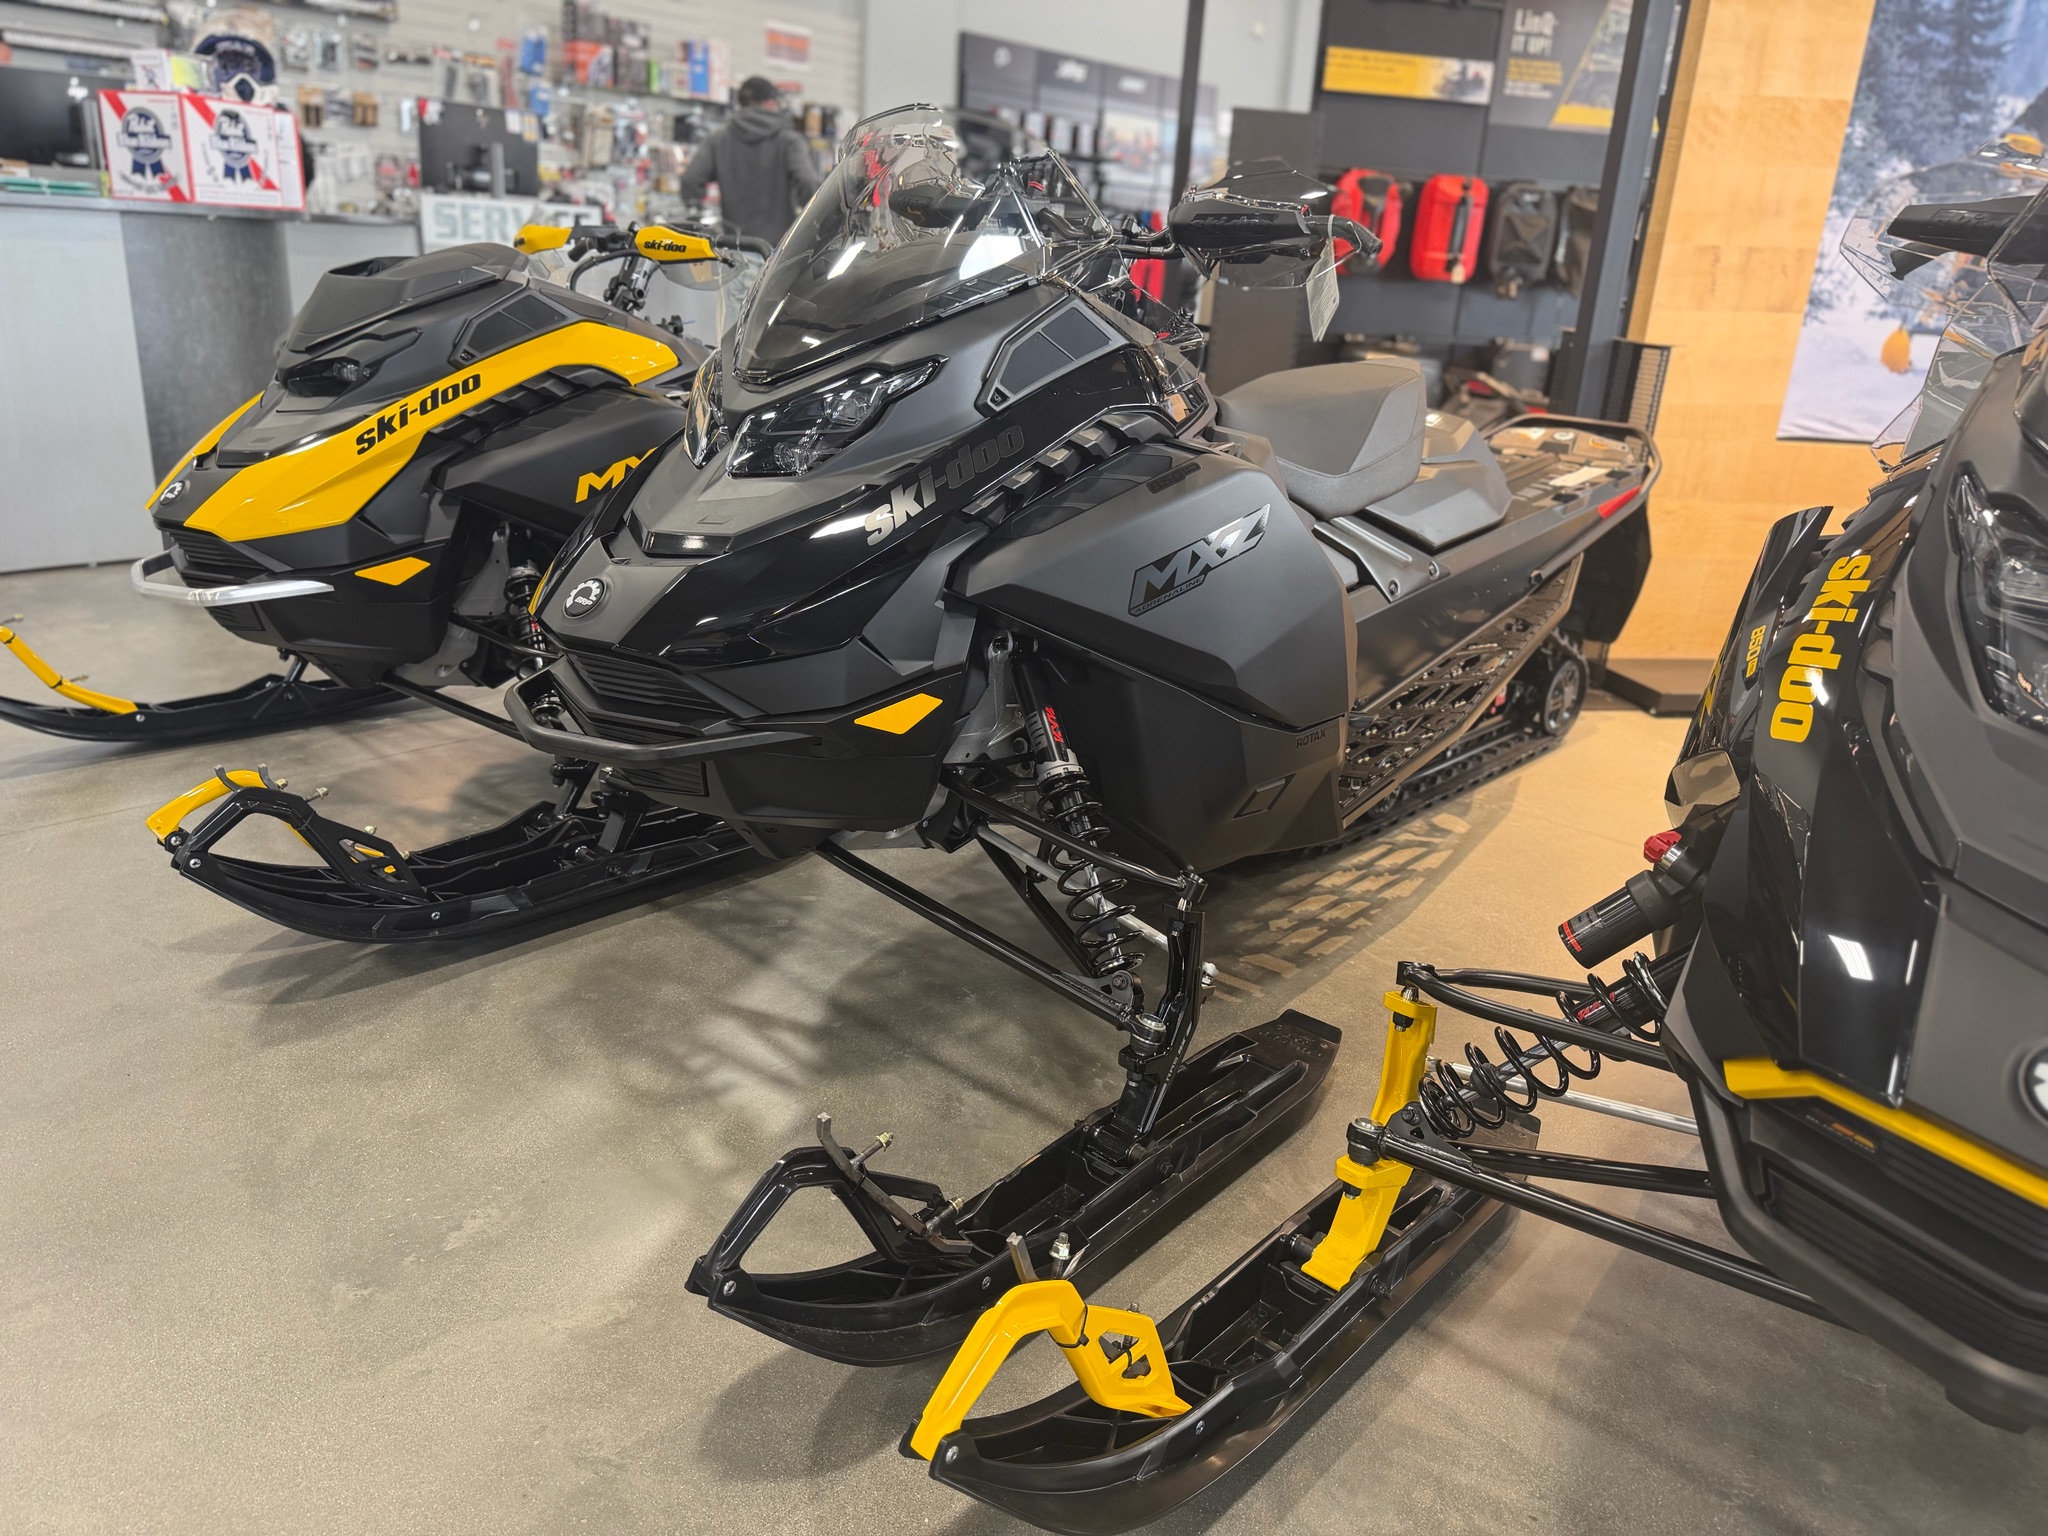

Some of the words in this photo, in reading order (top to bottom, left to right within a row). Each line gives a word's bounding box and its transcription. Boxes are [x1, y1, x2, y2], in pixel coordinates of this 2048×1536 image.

[643, 240, 687, 253] ski-doo
[355, 373, 482, 456] ski-doo
[864, 425, 1025, 546] ski-doo
[1130, 503, 1271, 606] MXZ
[574, 595, 593, 606] BRP
[1134, 575, 1203, 613] ADRENALINE
[1746, 624, 1767, 662] 850
[1770, 554, 1872, 744] ski-doo
[1295, 727, 1327, 749] ROTAX
